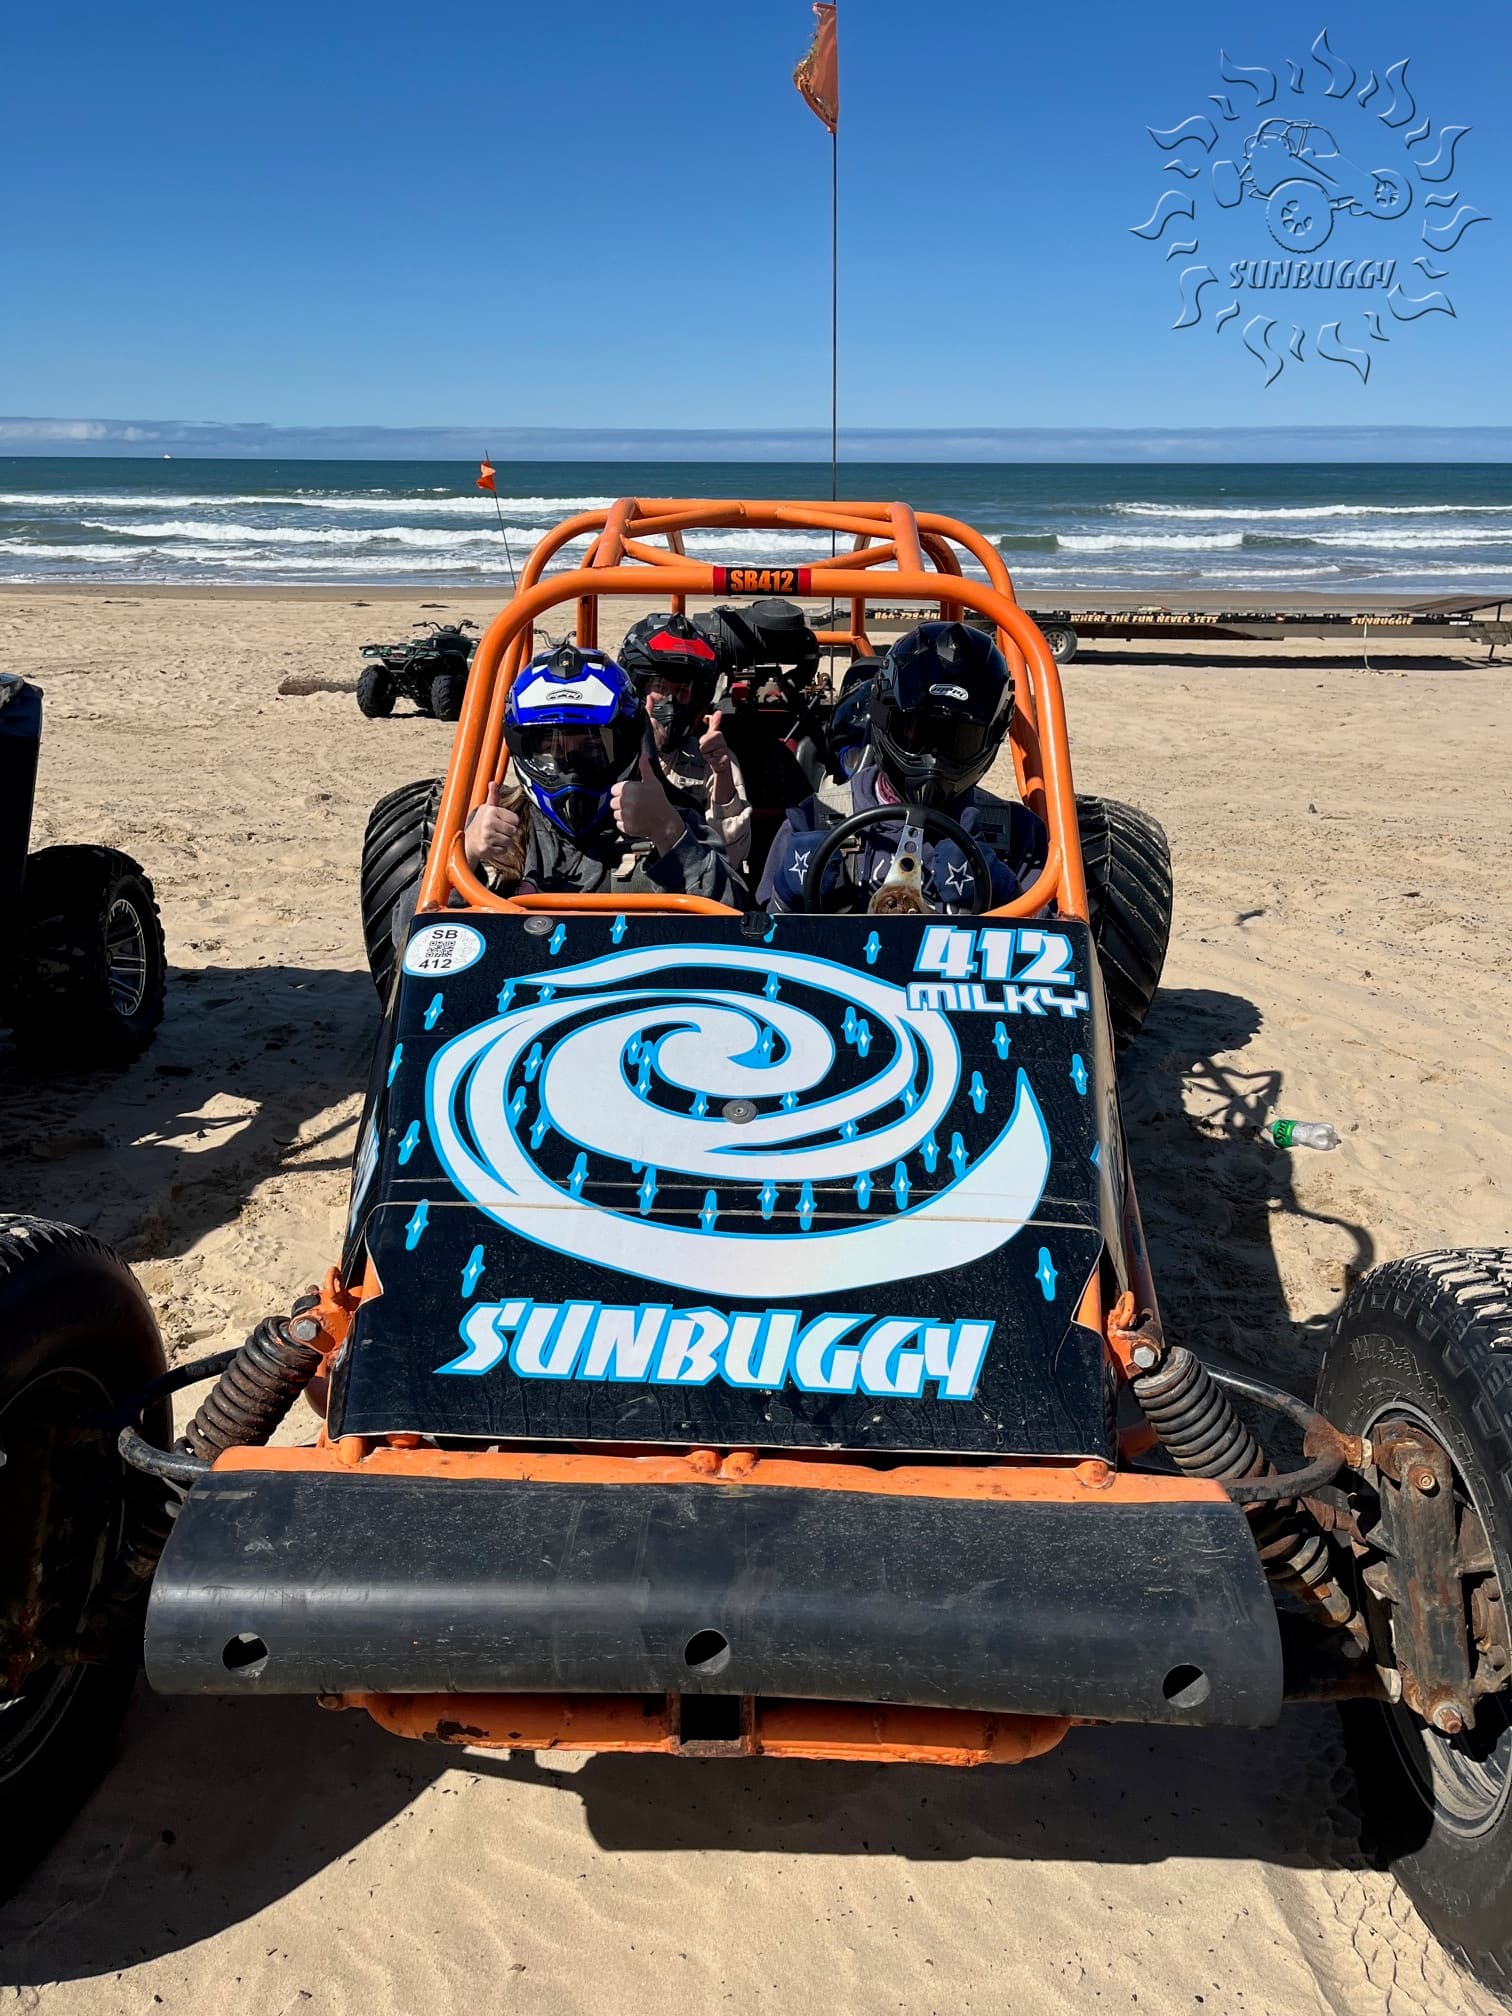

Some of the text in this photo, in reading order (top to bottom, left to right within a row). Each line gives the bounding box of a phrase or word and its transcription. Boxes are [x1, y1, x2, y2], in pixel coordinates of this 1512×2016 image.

[730, 569, 794, 592] SB412
[1070, 614, 1218, 623] WHERE THE FUN NEVER SETS
[431, 929, 459, 939] SB
[418, 958, 453, 969] 412
[913, 925, 1075, 986] 412
[906, 982, 1090, 1018] MILKY
[433, 1297, 996, 1401] SUNBUGGY
